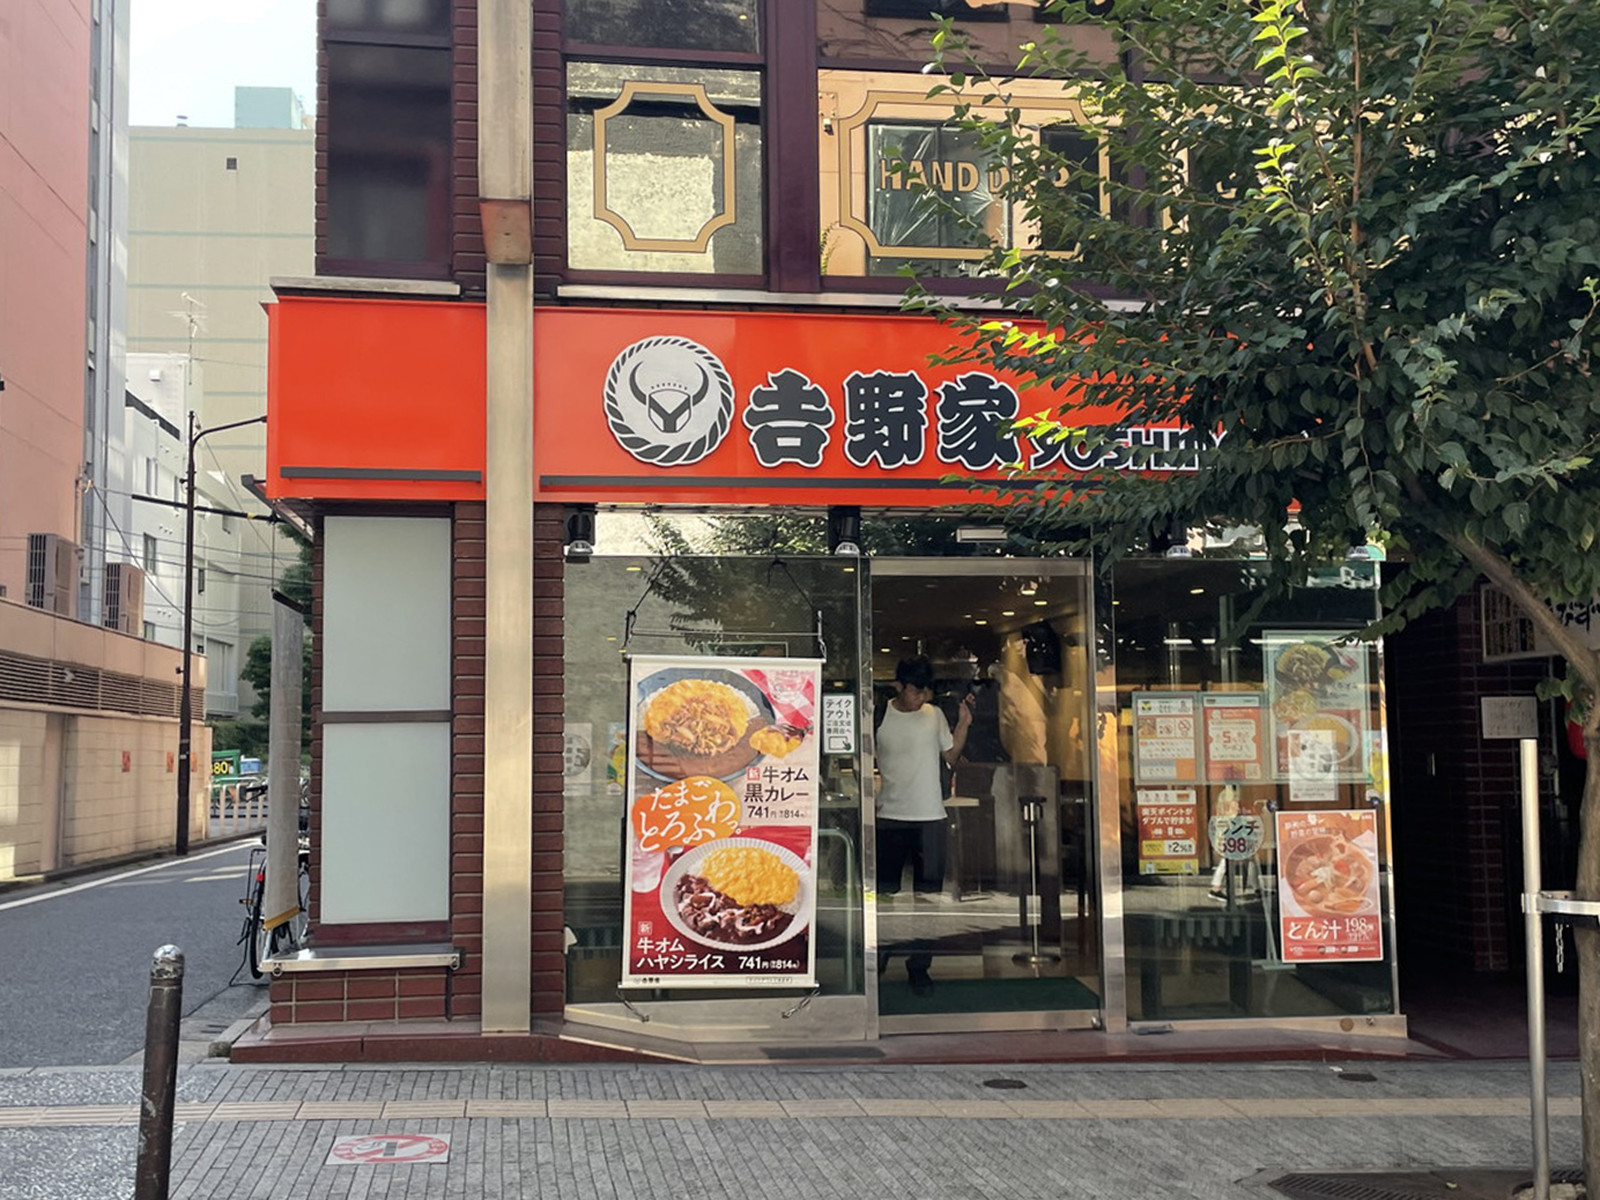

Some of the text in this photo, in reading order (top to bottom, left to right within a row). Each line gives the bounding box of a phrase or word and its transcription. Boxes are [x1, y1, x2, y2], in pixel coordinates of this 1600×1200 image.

[742, 367, 1022, 471] 吉野家
[826, 710, 851, 719] アウト
[211, 761, 229, 775] 80
[762, 766, 809, 783] 牛オム
[650, 780, 712, 811] たまご
[744, 783, 809, 802] 黒カレー
[1288, 919, 1342, 940] とん汁
[636, 937, 685, 954] 牛オム
[636, 953, 725, 970] ハヤシライス
